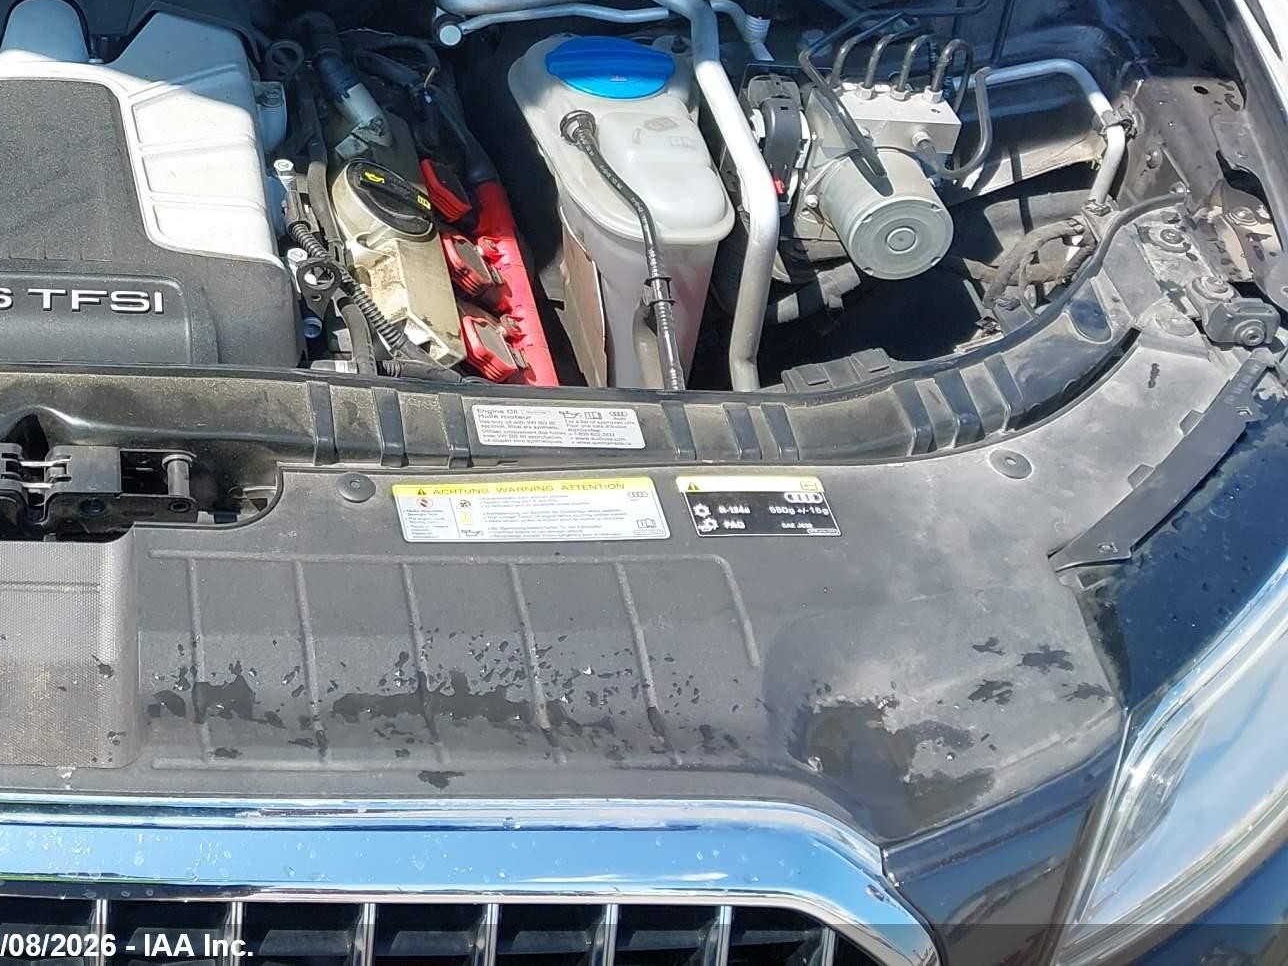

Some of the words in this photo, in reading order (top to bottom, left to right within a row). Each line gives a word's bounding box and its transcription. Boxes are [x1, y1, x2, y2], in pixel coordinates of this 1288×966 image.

[27, 288, 164, 314] TFSI
[476, 408, 505, 416] Engine
[495, 485, 554, 493] WARNING
[561, 483, 625, 491] ATTENTION
[718, 505, 751, 514] R-134a
